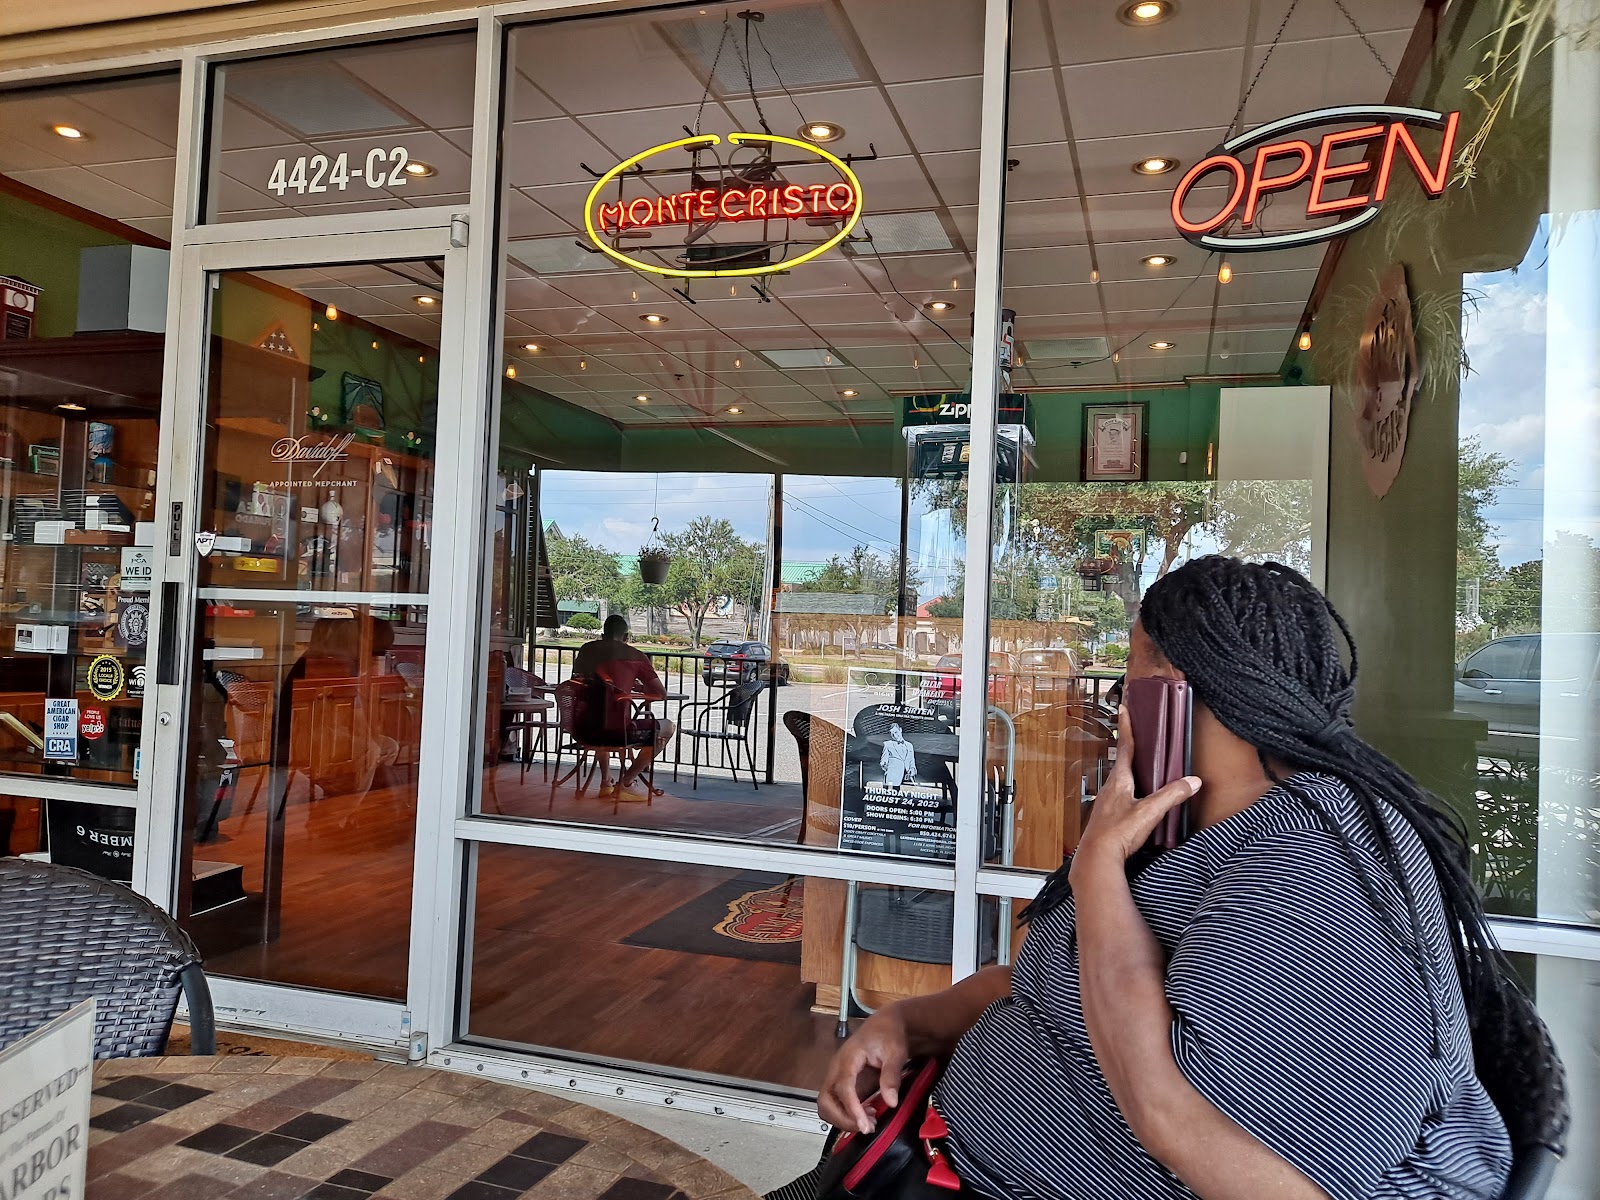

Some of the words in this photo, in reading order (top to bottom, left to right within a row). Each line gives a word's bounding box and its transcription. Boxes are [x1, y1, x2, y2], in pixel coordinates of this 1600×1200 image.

[267, 146, 409, 196] 4424-C2
[1170, 111, 1460, 233] OPEN
[597, 182, 856, 231] MONTECRISTO
[270, 432, 356, 478] Davidoff
[269, 480, 313, 488] APPOINTED
[173, 504, 182, 541] PULL
[125, 567, 140, 575] WE
[142, 567, 152, 576] ID
[876, 704, 901, 713] JOSH
[903, 706, 935, 716] SIRTEN
[48, 739, 72, 752] CRA
[864, 786, 909, 798] THURSDAY
[910, 792, 938, 800] NIGHT
[862, 794, 900, 804] AUGUST
[901, 798, 915, 807] 24,
[917, 800, 940, 809] 2023
[866, 805, 888, 813] DOORS
[889, 807, 909, 815] OPEN:
[866, 811, 885, 819] SHOW
[886, 813, 909, 821] BEGINS:
[843, 822, 877, 831] $10/PERSON
